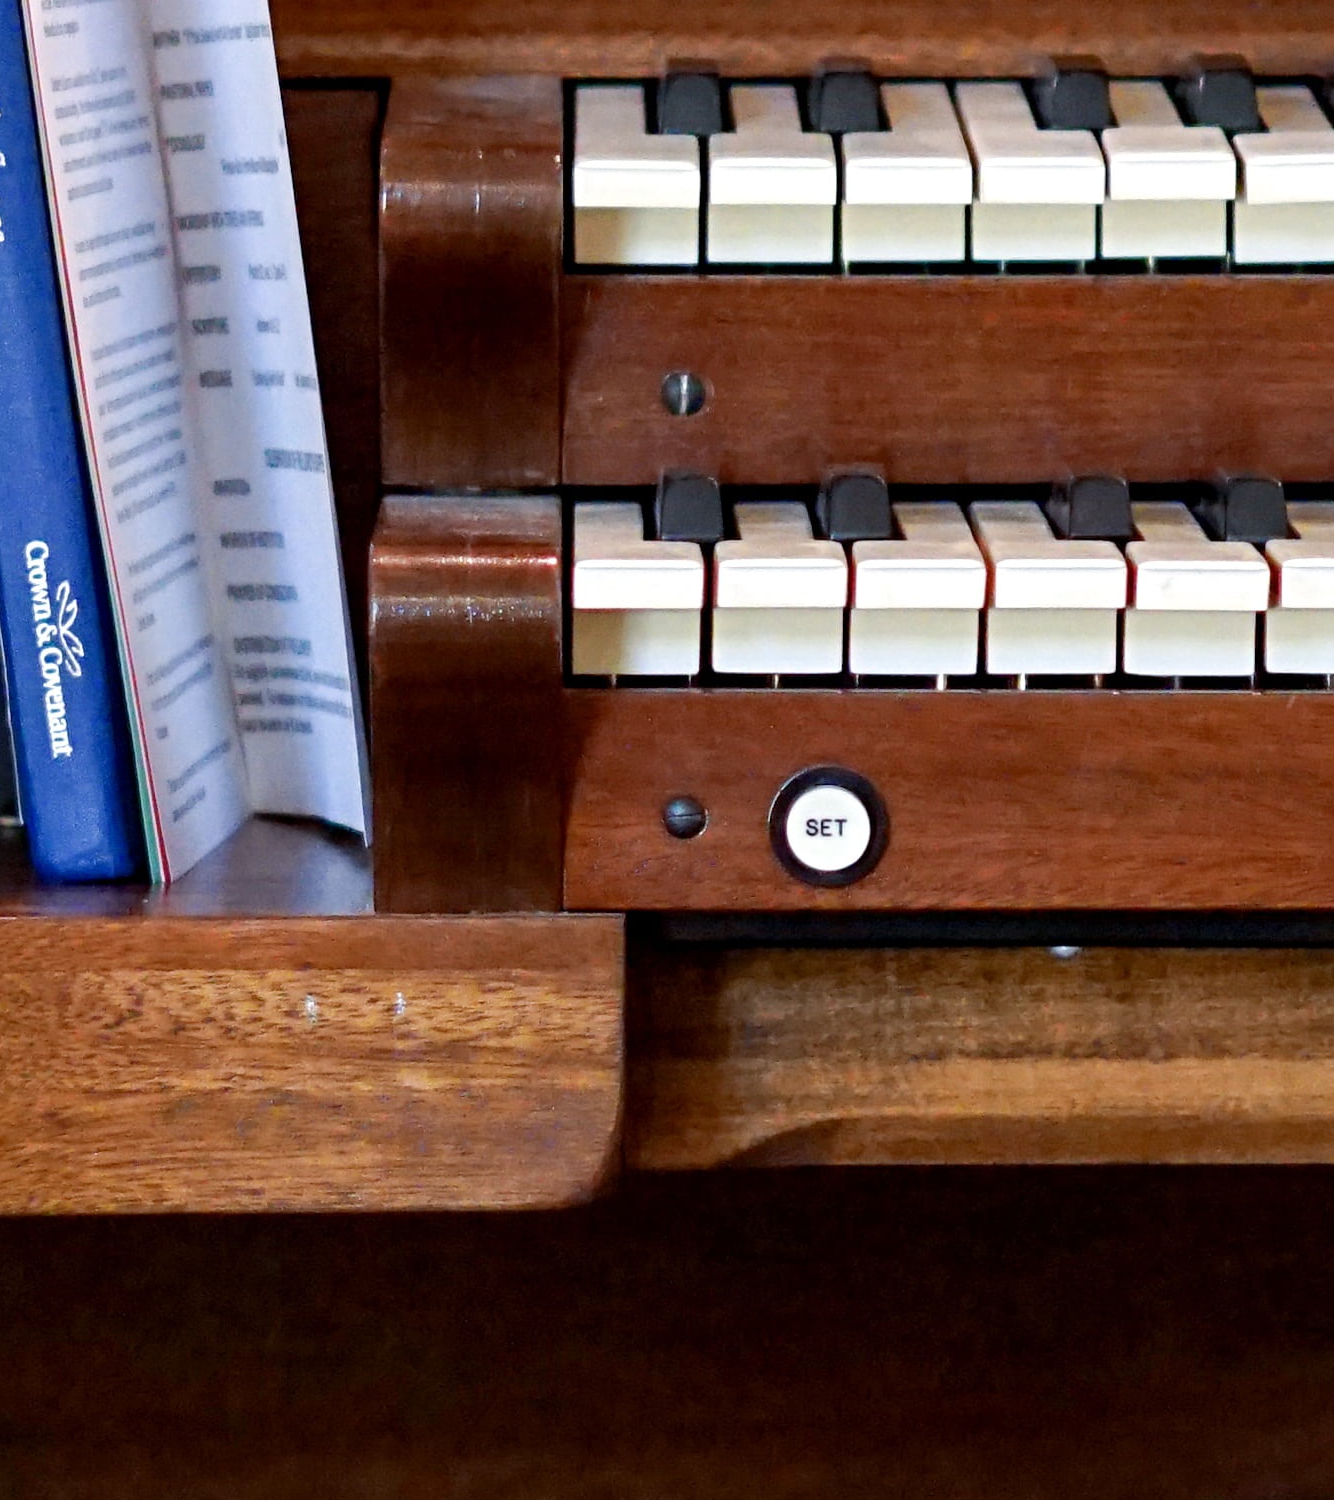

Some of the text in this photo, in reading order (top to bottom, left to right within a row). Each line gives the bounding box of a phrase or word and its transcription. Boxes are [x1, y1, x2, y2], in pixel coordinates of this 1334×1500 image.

[25, 540, 75, 759] Crown & Covenant
[805, 818, 848, 837] SET
